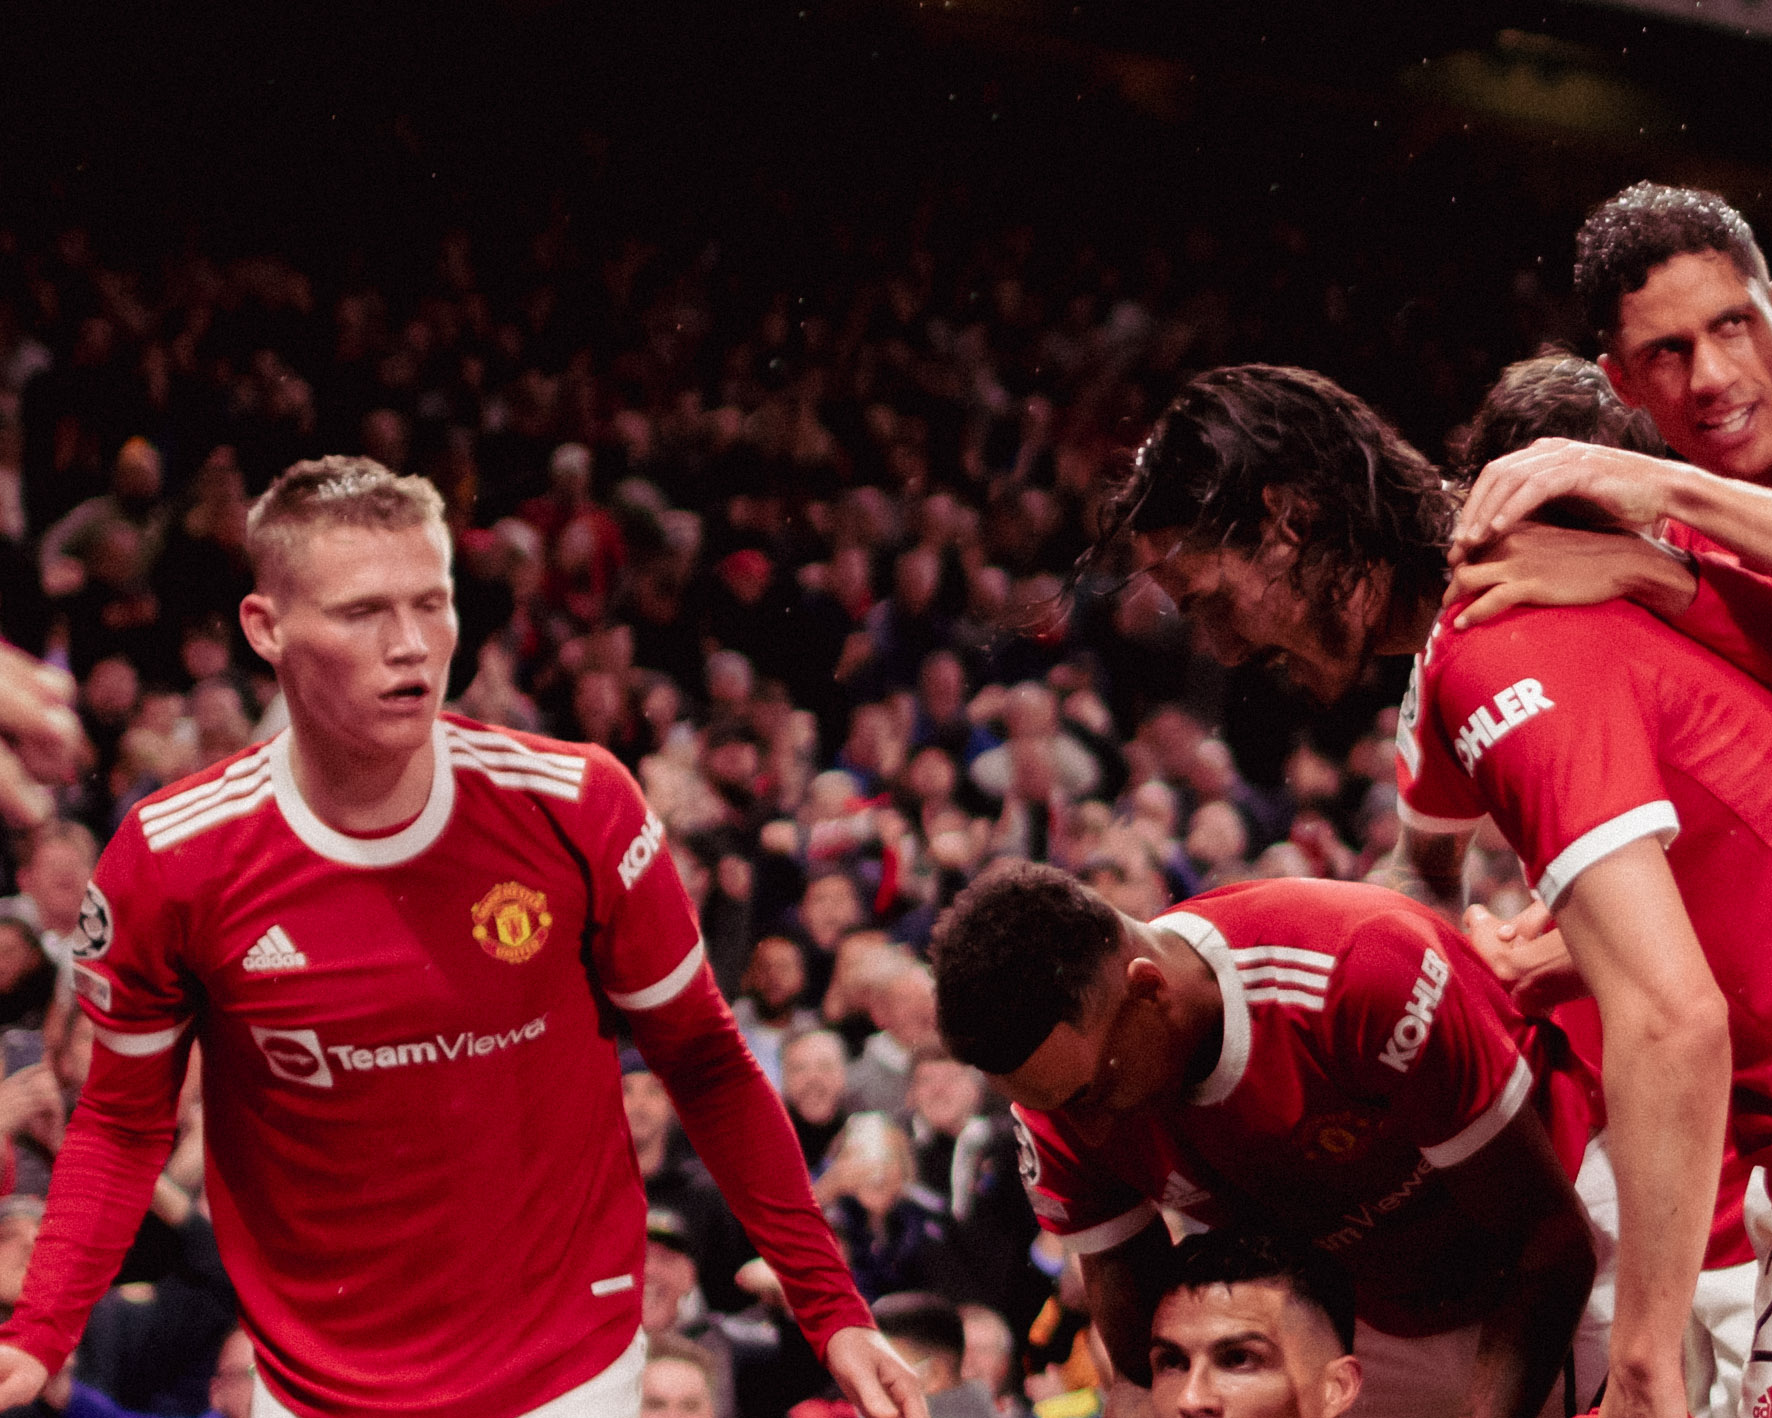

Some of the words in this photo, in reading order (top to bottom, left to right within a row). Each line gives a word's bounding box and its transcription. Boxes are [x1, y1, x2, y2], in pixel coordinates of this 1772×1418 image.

[1454, 677, 1556, 778] OHLER
[616, 808, 664, 892] KOH
[242, 951, 307, 972] adidas
[327, 1012, 548, 1071] TeamViewer
[1311, 1157, 1433, 1252] mViewe
